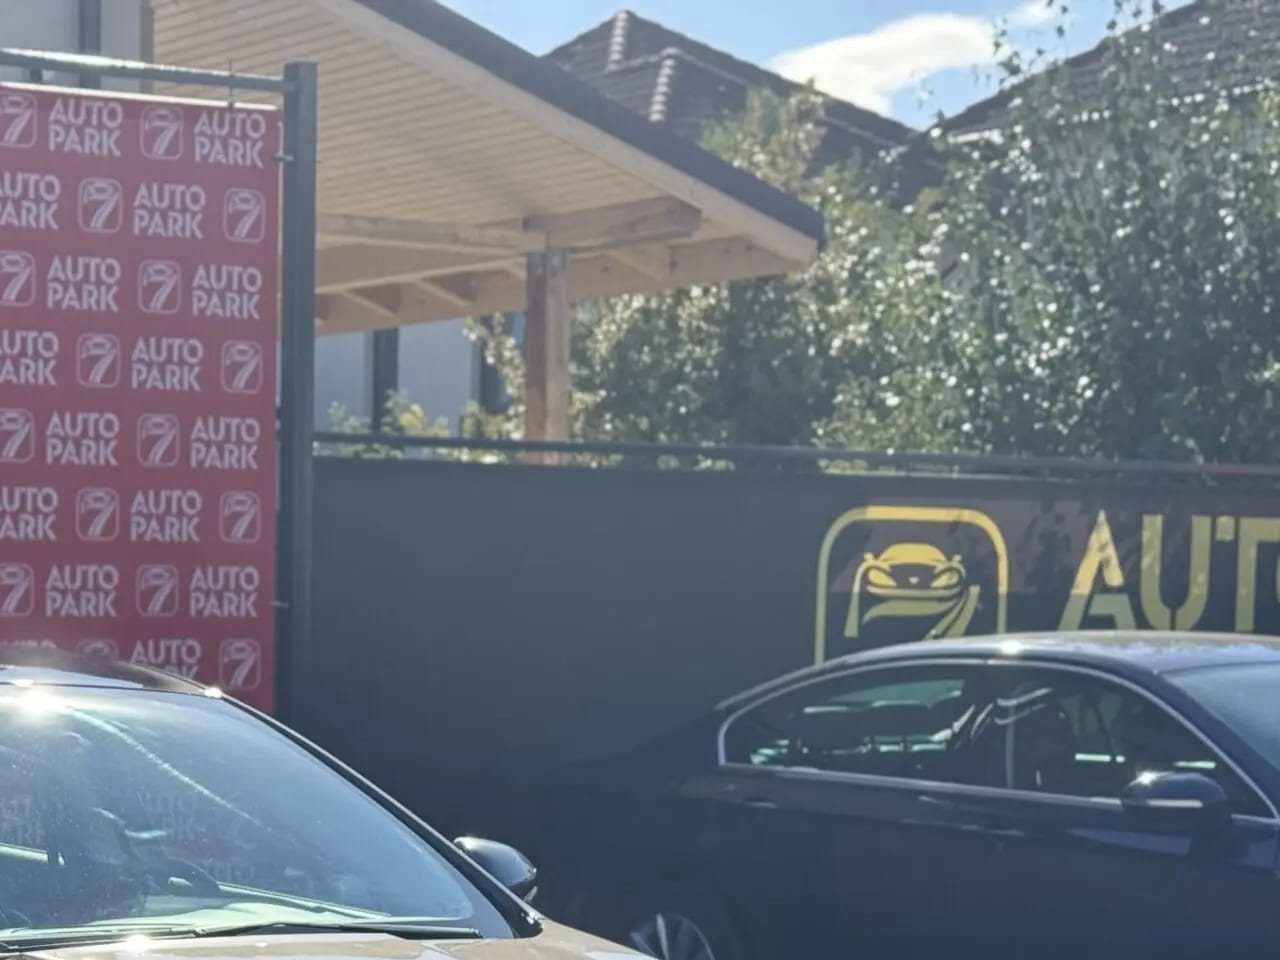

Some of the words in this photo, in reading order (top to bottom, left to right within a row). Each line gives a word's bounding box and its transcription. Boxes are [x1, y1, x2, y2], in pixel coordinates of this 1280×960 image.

[48, 98, 122, 127] AUTO
[194, 111, 266, 138] AUTO
[49, 124, 120, 156] PARK
[195, 135, 264, 168] PARK
[134, 183, 206, 211] AUTO
[134, 209, 203, 239] PARK
[47, 256, 121, 284] AUTO
[192, 264, 262, 292] AUTO
[47, 281, 118, 312] PARK
[193, 290, 260, 319] PARK
[132, 337, 203, 364] AUTO
[132, 363, 200, 391] PARK
[46, 412, 120, 438] AUTO
[191, 416, 260, 443] AUTO
[46, 437, 117, 465] PARK
[191, 442, 258, 469] PARK
[131, 490, 202, 515] AUTO
[131, 515, 199, 541] PARK
[46, 564, 119, 590] AUTO
[190, 566, 259, 592] AUTO
[1057, 509, 1280, 631] AUT
[46, 590, 116, 617] PARK
[190, 592, 257, 617] PARK
[130, 639, 202, 665] AUTO
